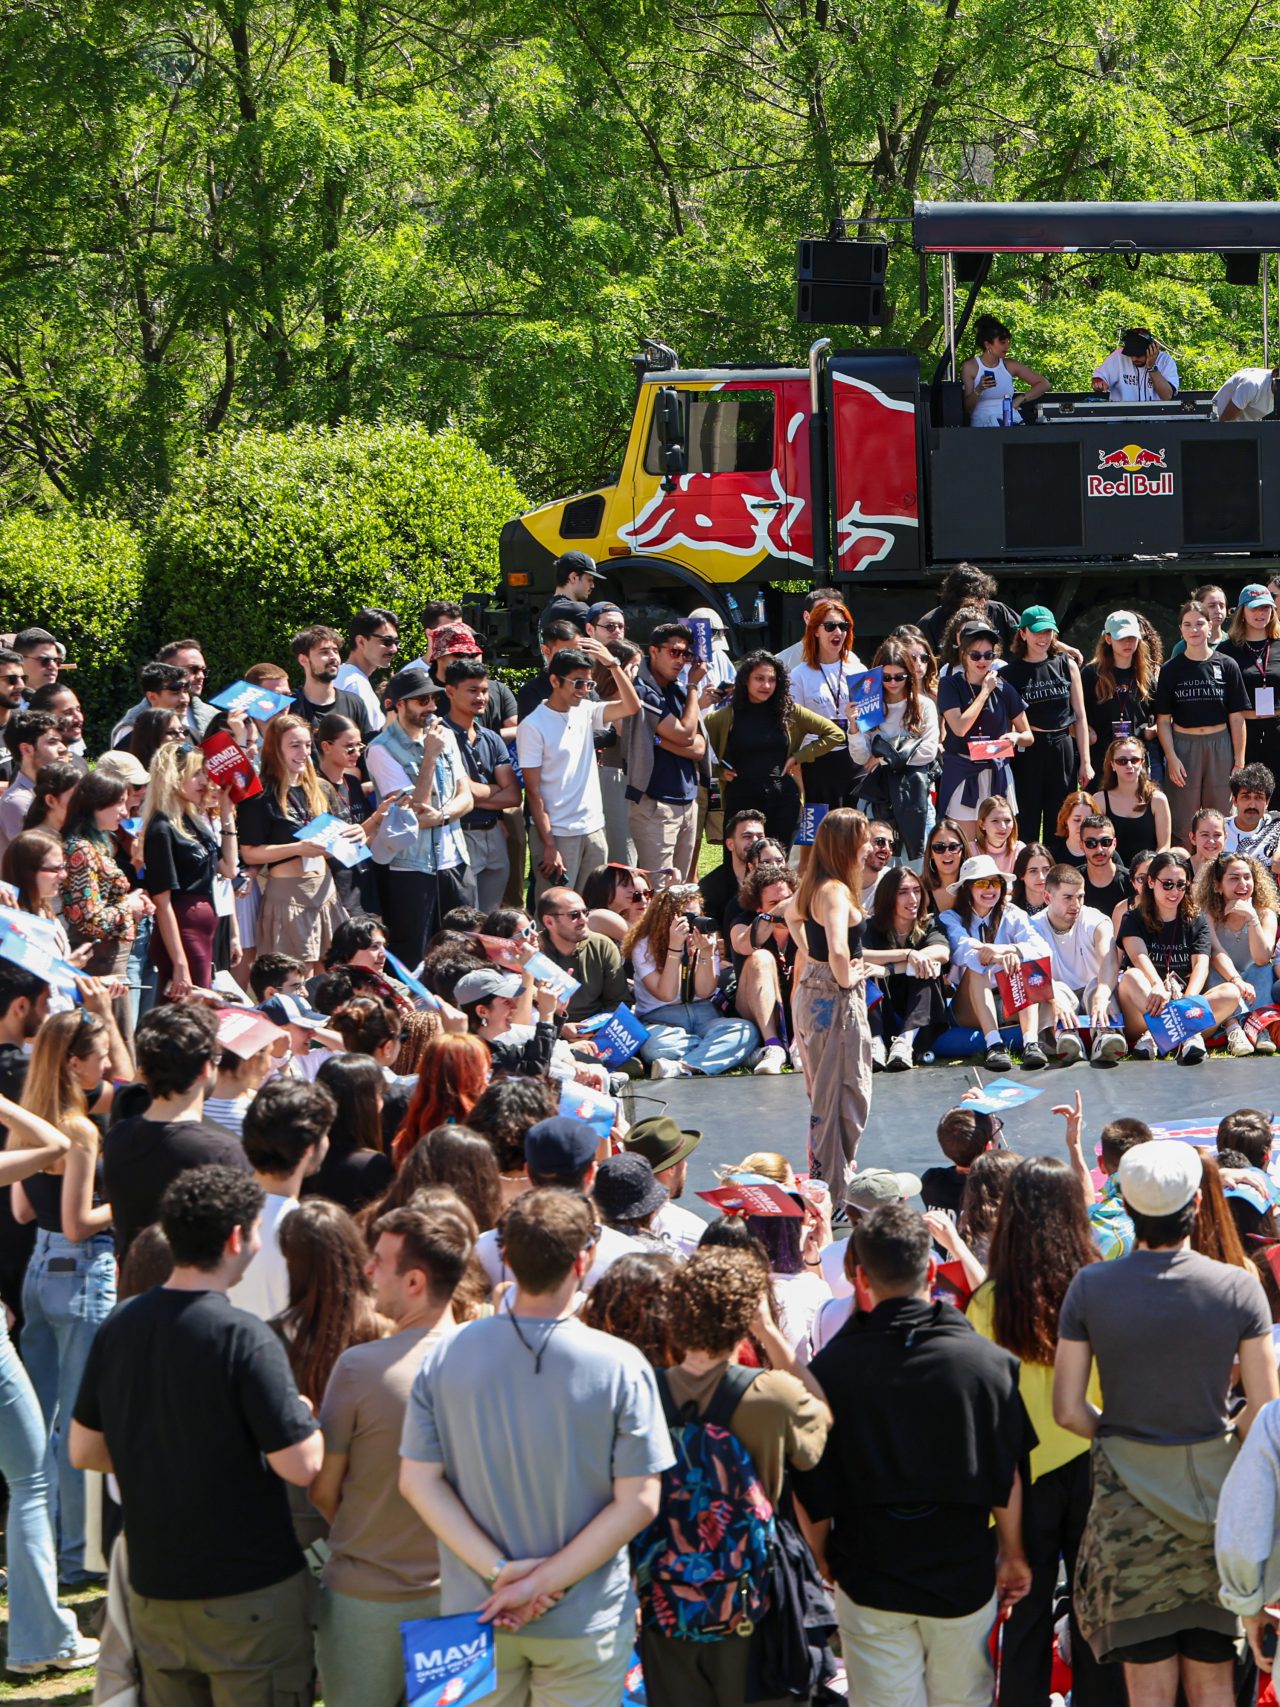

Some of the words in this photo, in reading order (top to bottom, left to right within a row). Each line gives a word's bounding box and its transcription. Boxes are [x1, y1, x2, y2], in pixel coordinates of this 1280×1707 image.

[1087, 473, 1130, 496] Red
[1132, 472, 1174, 496] Bull
[206, 744, 240, 771] KIRMIZI
